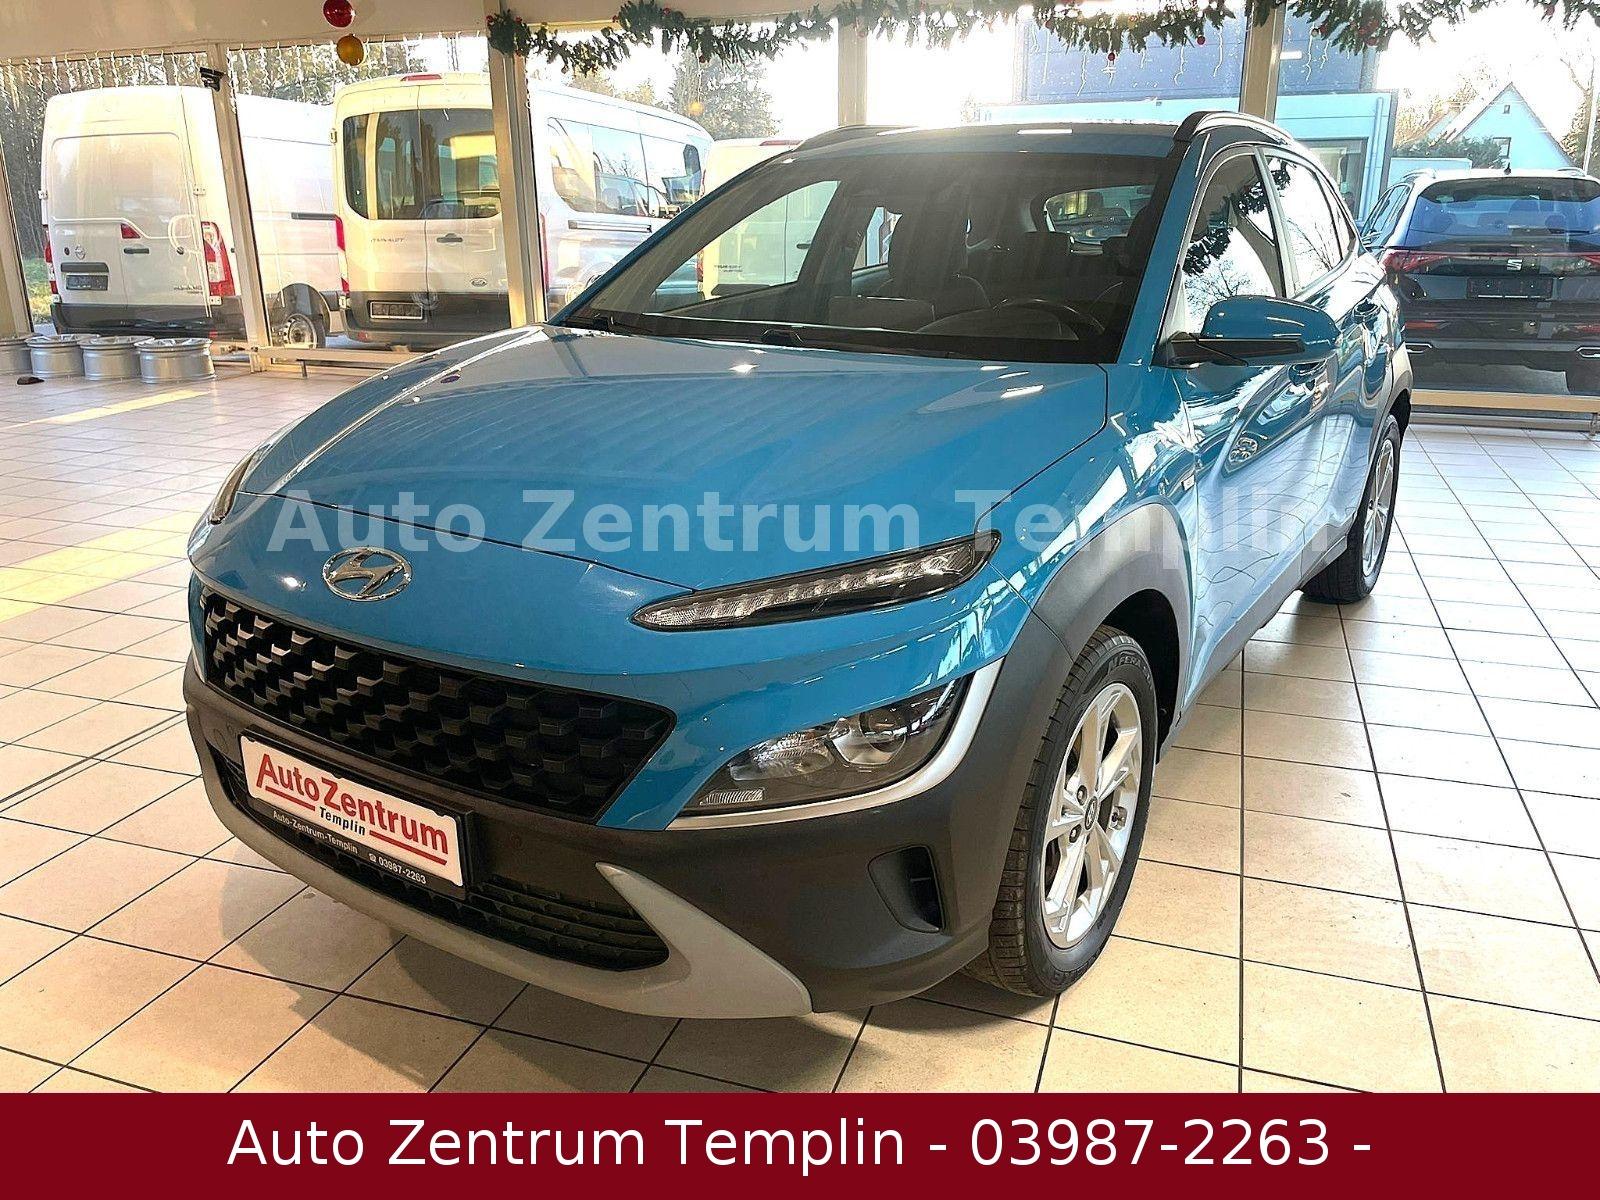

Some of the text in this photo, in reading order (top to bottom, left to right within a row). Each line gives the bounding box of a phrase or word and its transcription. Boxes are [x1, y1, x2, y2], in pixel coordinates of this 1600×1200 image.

[319, 806, 366, 836] Templin
[273, 810, 427, 885] Auto-Zentrum-Templin 03987-2263
